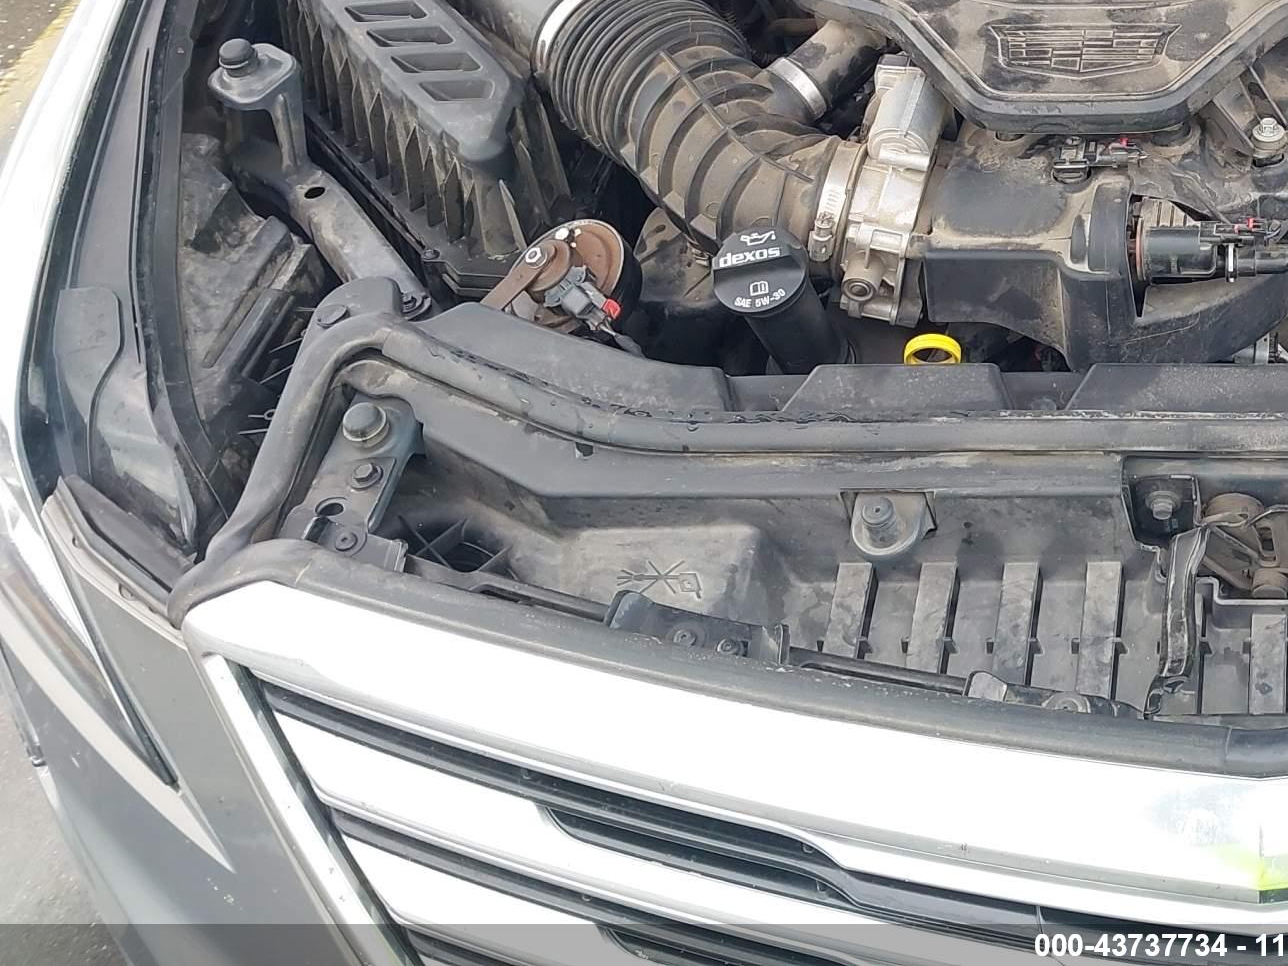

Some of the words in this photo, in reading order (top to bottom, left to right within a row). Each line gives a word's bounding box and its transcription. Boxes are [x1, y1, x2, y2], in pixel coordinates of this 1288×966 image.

[720, 247, 781, 267] dexos
[734, 297, 752, 308] SAE
[755, 288, 786, 307] 5W-30
